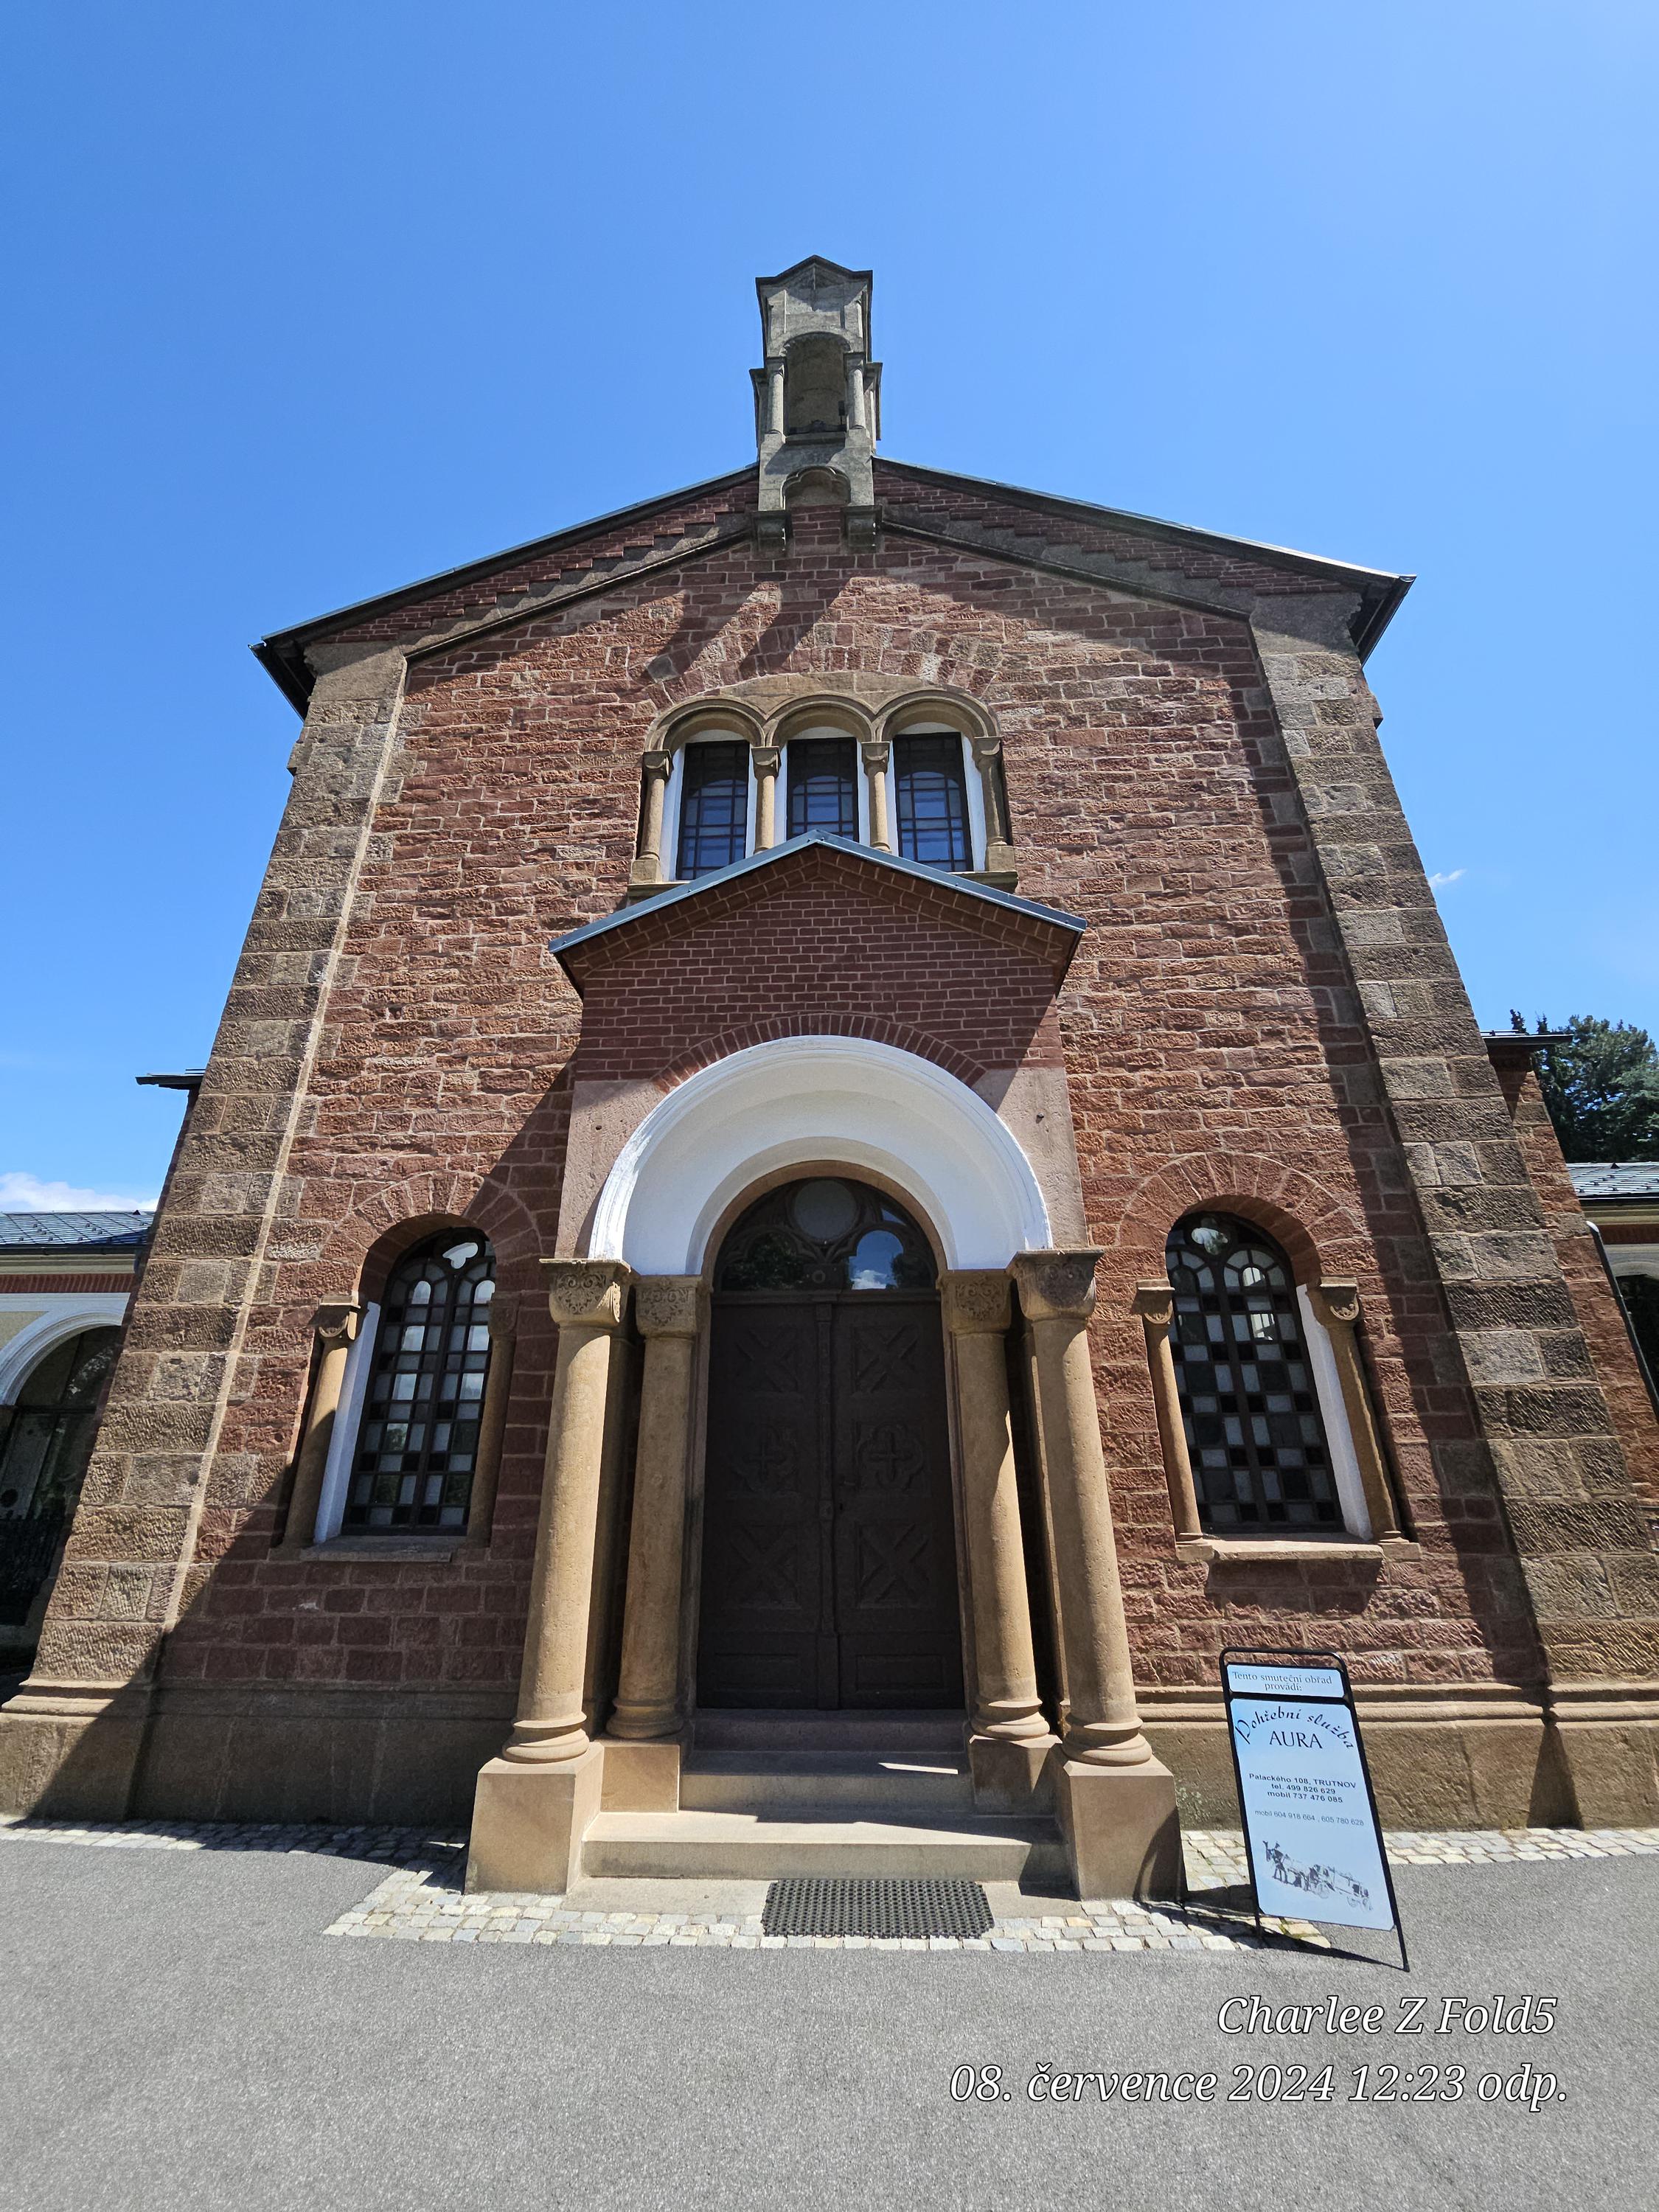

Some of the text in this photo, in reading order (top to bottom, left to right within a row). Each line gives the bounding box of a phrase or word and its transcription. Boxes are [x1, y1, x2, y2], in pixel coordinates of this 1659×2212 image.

[1232, 1671, 1332, 1684] Tento smuteční obřad
[1265, 1682, 1302, 1691] provádí:
[1234, 1705, 1354, 1749] Pohřební služba
[1269, 1731, 1323, 1749] AURA
[1249, 1773, 1291, 1783] Palackého
[1312, 1778, 1357, 1789] TRUTNOV
